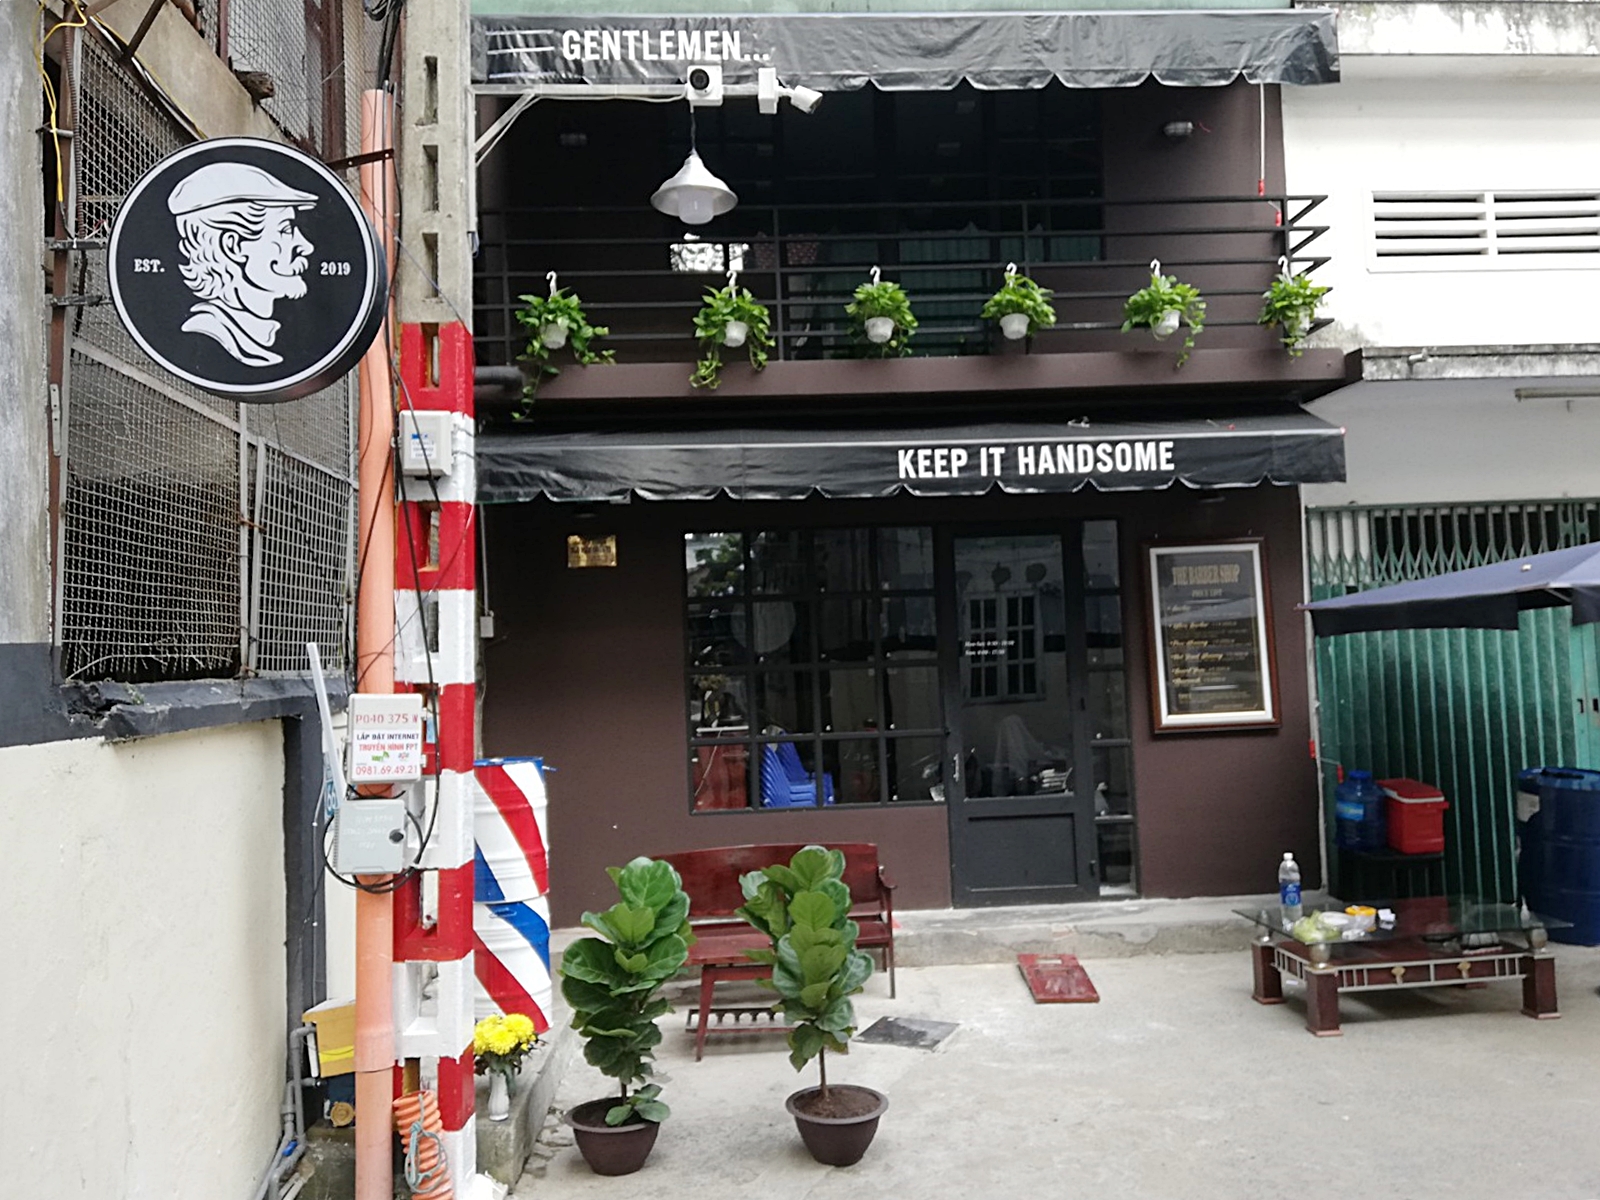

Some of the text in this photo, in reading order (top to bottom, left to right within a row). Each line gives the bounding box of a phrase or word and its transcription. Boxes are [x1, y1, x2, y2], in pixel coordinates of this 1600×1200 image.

[133, 258, 165, 273] EST.
[320, 261, 351, 276] 2019
[898, 441, 1175, 479] KEEP IT HANDSOME
[387, 713, 409, 724] 375
[355, 765, 418, 775] 0981.69.49.21
